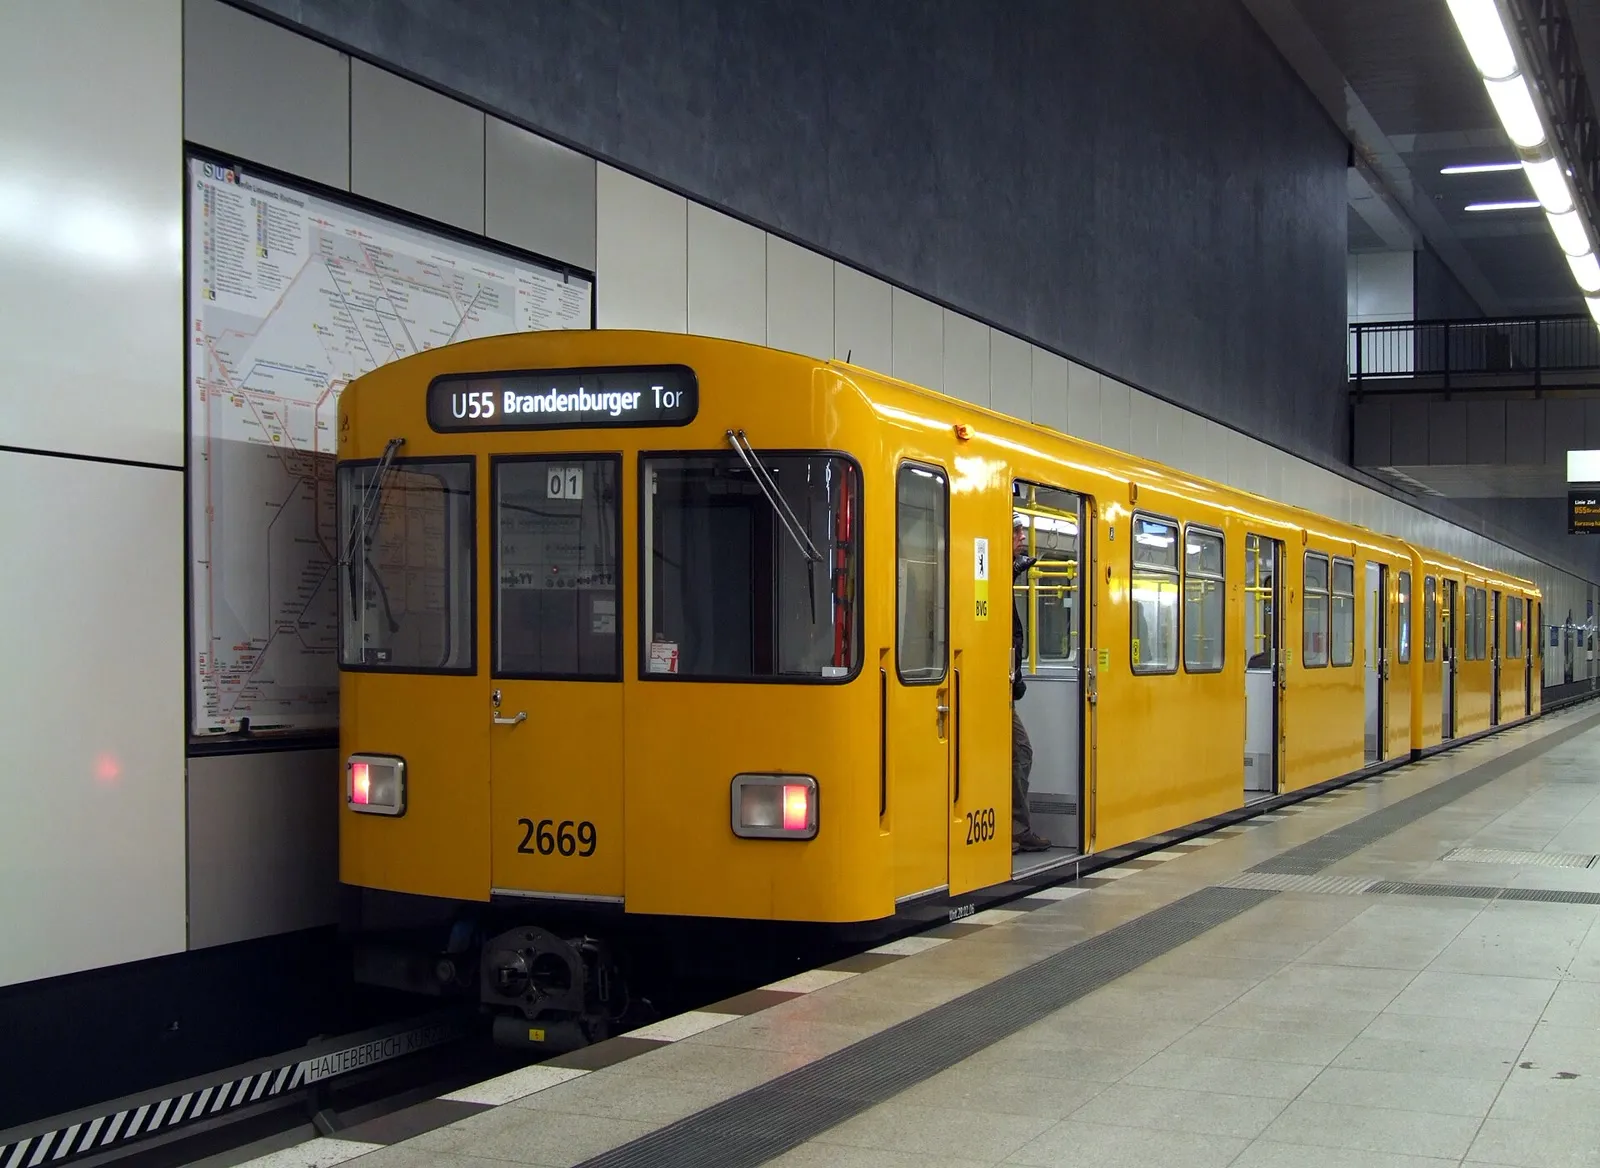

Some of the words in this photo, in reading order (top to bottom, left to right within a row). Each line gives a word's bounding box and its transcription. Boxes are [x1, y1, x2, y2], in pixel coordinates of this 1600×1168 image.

[452, 391, 495, 419] U55
[504, 387, 641, 416] Brandenburger
[651, 386, 684, 409] Tor
[550, 474, 577, 496] 01
[975, 600, 987, 616] BVG
[517, 818, 597, 857] 2669
[966, 808, 995, 846] 2669
[310, 1037, 401, 1081] HALTEBEREICH
